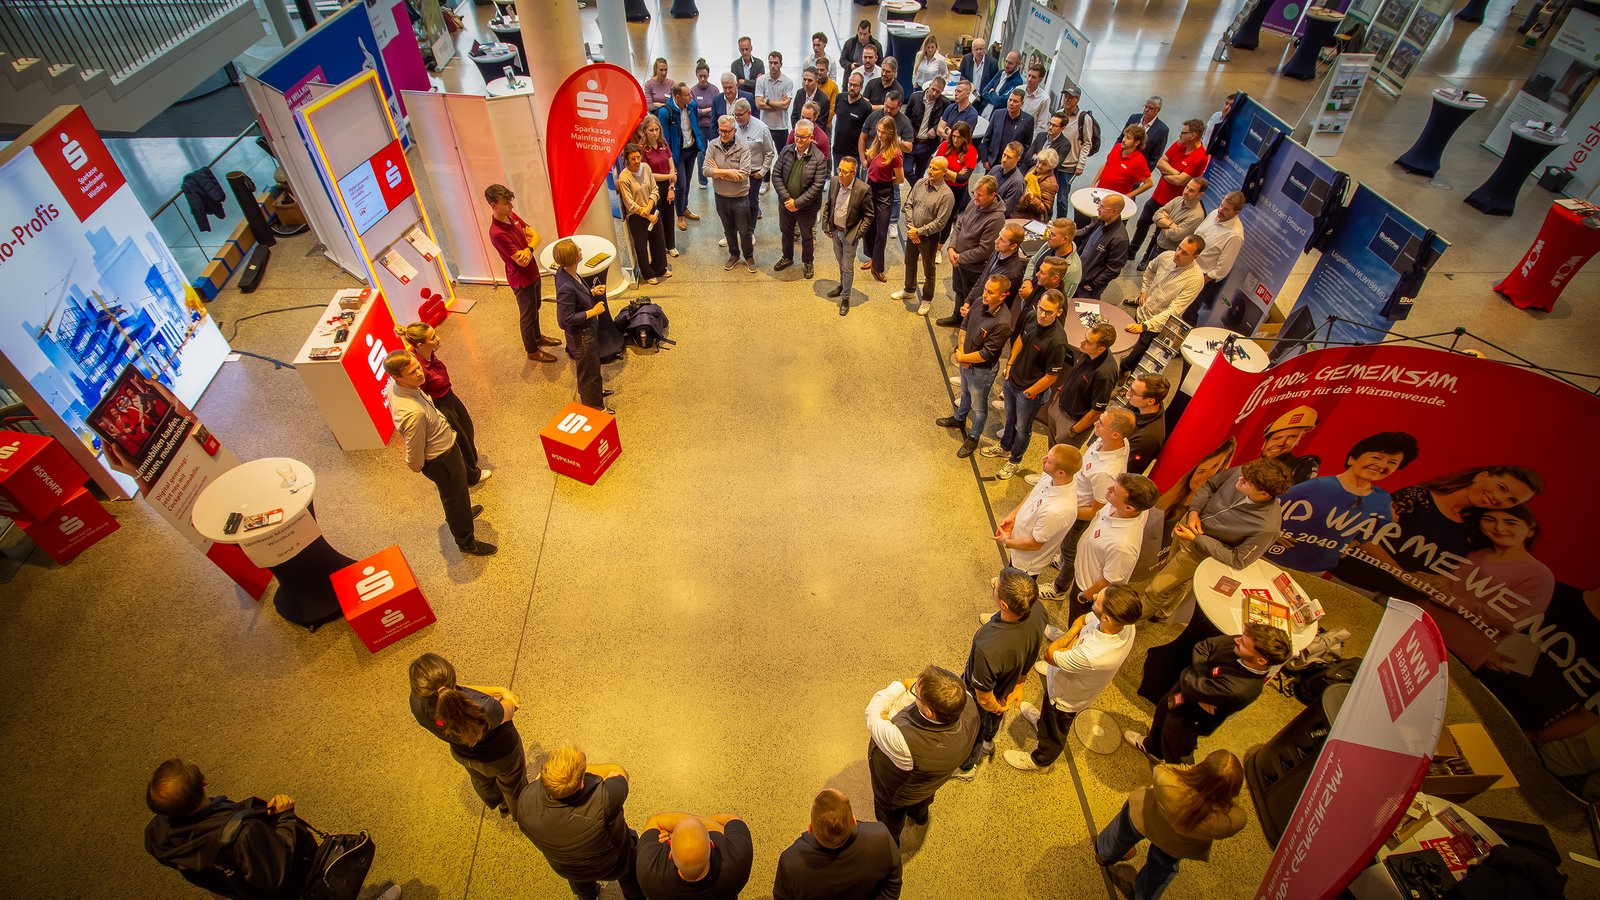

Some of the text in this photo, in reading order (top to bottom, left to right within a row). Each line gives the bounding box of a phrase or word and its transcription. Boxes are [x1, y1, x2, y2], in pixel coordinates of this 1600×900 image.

[1034, 10, 1052, 25] DAIKIN
[571, 133, 616, 144] Mainfranken
[574, 125, 611, 135] Sparkasse
[576, 142, 611, 153] Würzburg
[78, 166, 97, 184] Sparkasse
[81, 172, 104, 193] Mainfranken
[87, 181, 107, 198] Würzburg
[1290, 175, 1308, 191] Buderus
[1380, 231, 1399, 250] Buderus
[1521, 239, 1545, 278] WOLF
[1550, 255, 1583, 288] WOLF
[1271, 364, 1458, 394] 100% GEMEINSAM.
[1312, 386, 1332, 396] für
[1333, 385, 1352, 394] die
[1356, 385, 1447, 407] Wärmewende.
[136, 417, 181, 476] Immobilien kaufen,
[142, 458, 164, 482] bauen,
[160, 414, 191, 462] modernisieren.
[32, 465, 63, 496] #SPKMFR
[155, 480, 172, 502] Digital
[168, 457, 189, 485] gemanagt
[162, 473, 187, 508] jetzt neu mit
[167, 491, 184, 512] Cockpit
[180, 466, 201, 495] Immobilie.
[244, 513, 307, 548] Sparkasse Mainfranken
[1280, 529, 1500, 644] is 2040 klimaneutral wird.
